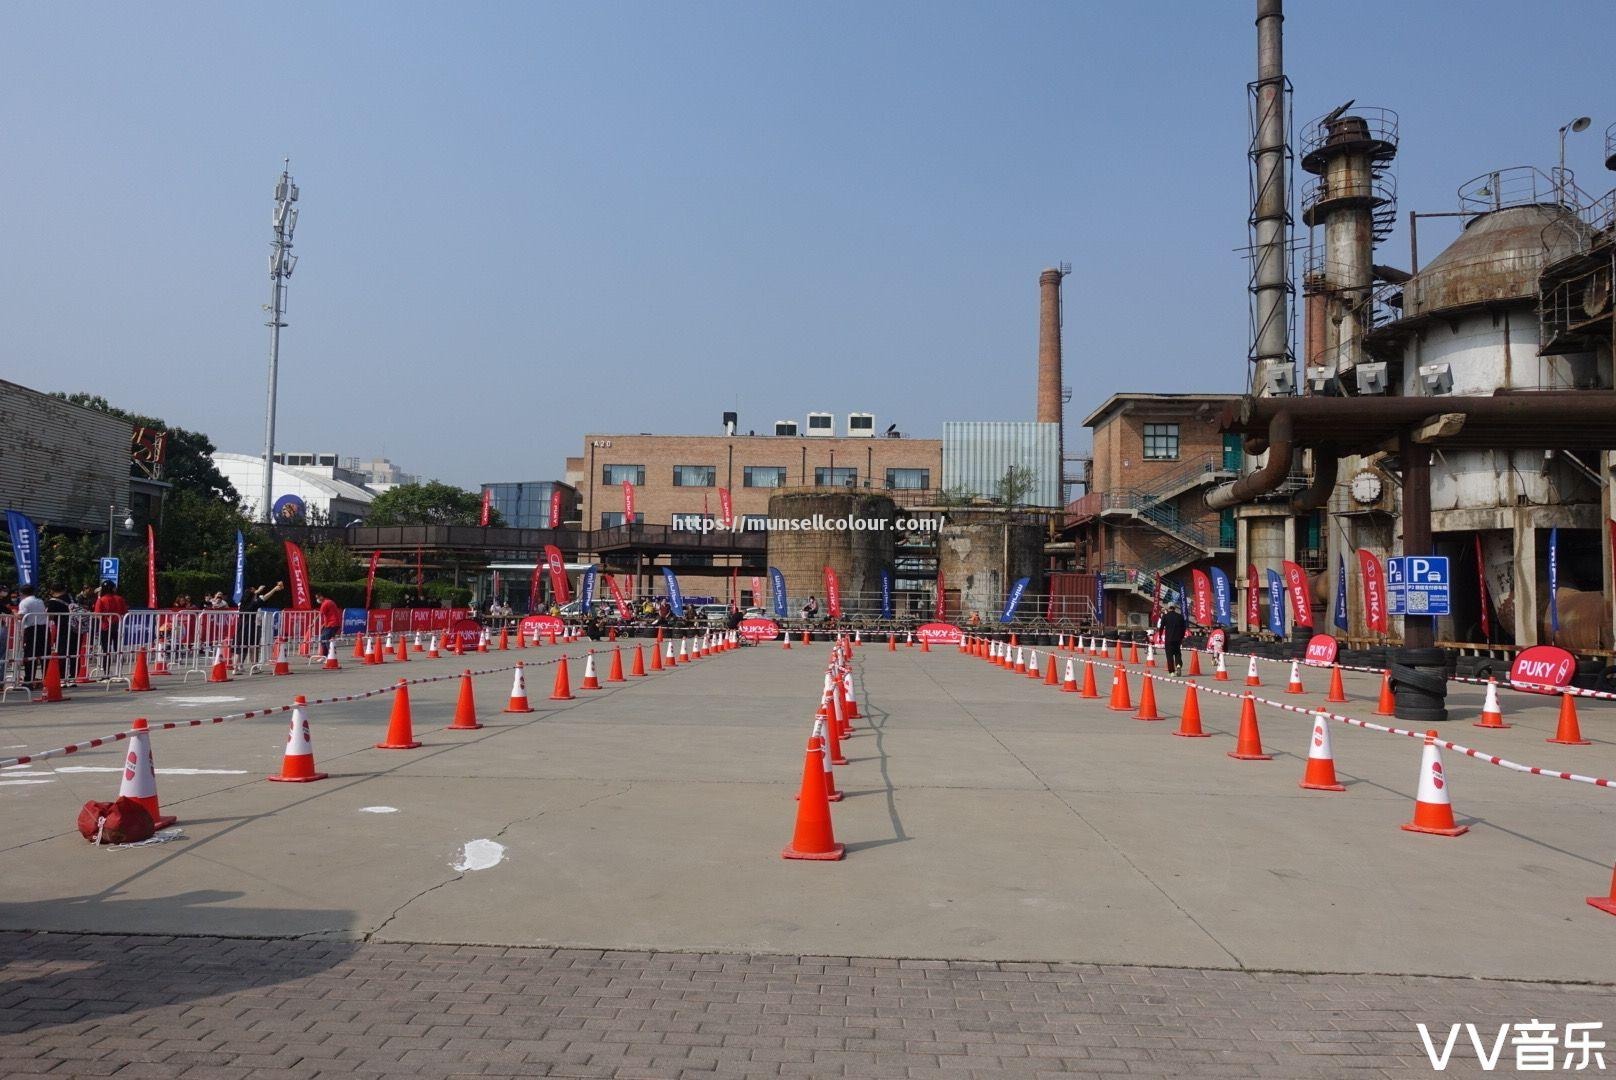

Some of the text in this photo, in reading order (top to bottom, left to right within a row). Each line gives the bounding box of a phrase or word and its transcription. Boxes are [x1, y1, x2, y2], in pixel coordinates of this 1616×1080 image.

[594, 440, 611, 448] A20
[103, 559, 113, 574] P
[1389, 560, 1397, 583] P
[1413, 559, 1430, 582] P
[414, 611, 430, 621] PUKY
[434, 610, 447, 620] PUKY
[524, 622, 550, 630] PUKY
[1309, 644, 1327, 656] PUKY
[1518, 659, 1555, 678] PUKY
